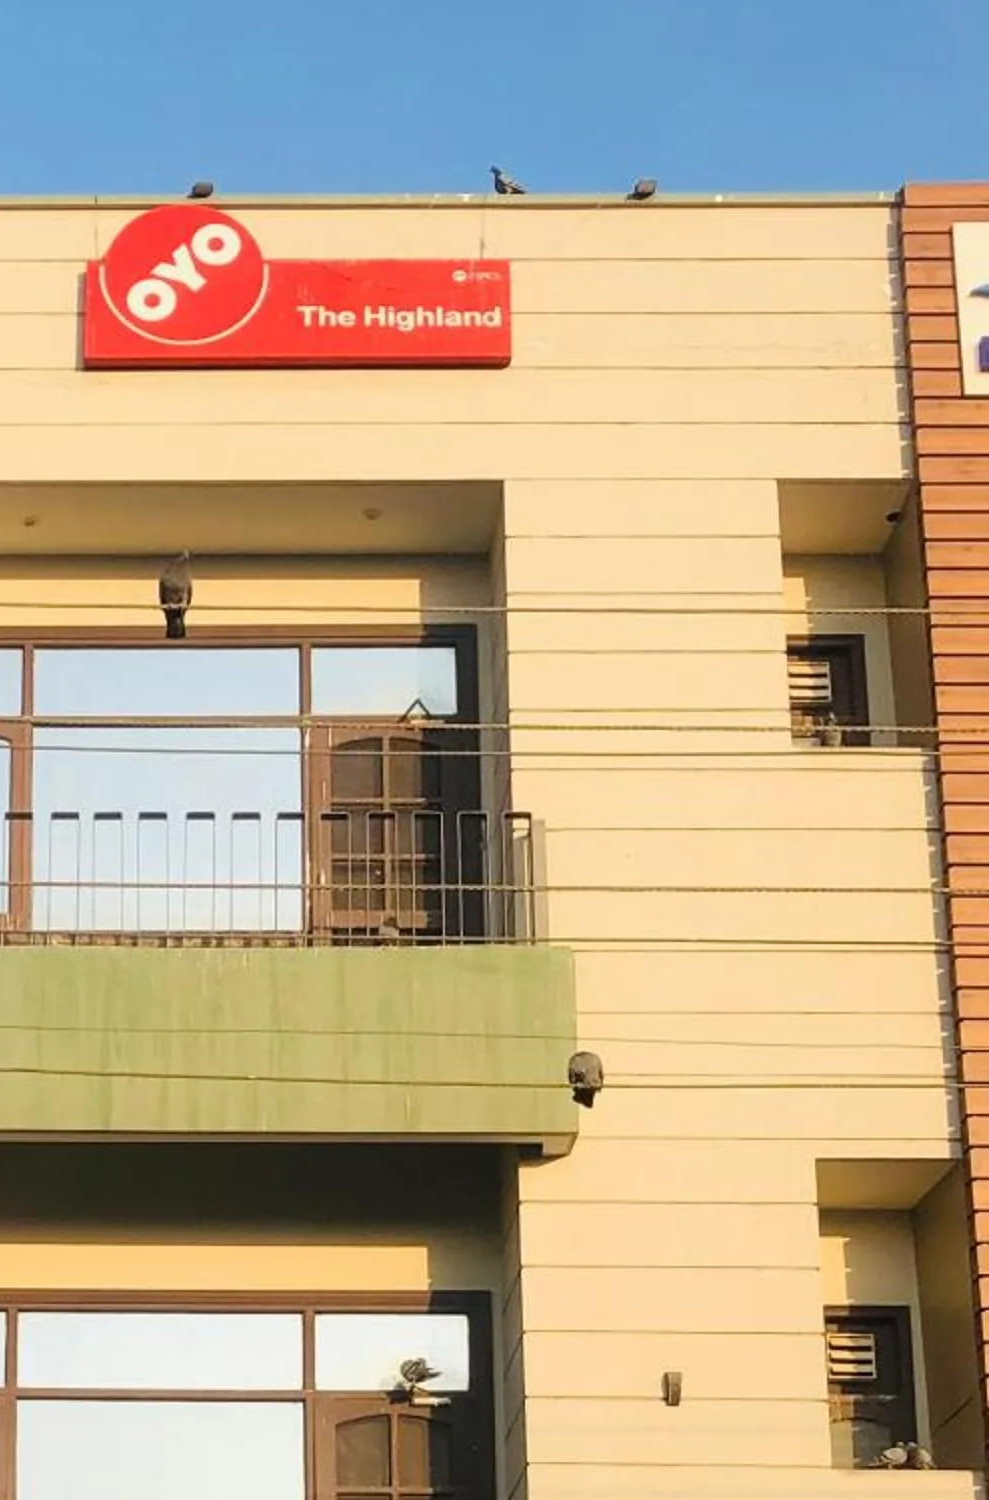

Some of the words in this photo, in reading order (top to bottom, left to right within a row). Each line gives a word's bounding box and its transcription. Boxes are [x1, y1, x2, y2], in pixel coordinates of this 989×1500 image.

[126, 223, 242, 322] OYO
[296, 305, 356, 327] The
[364, 305, 502, 331] Highland
